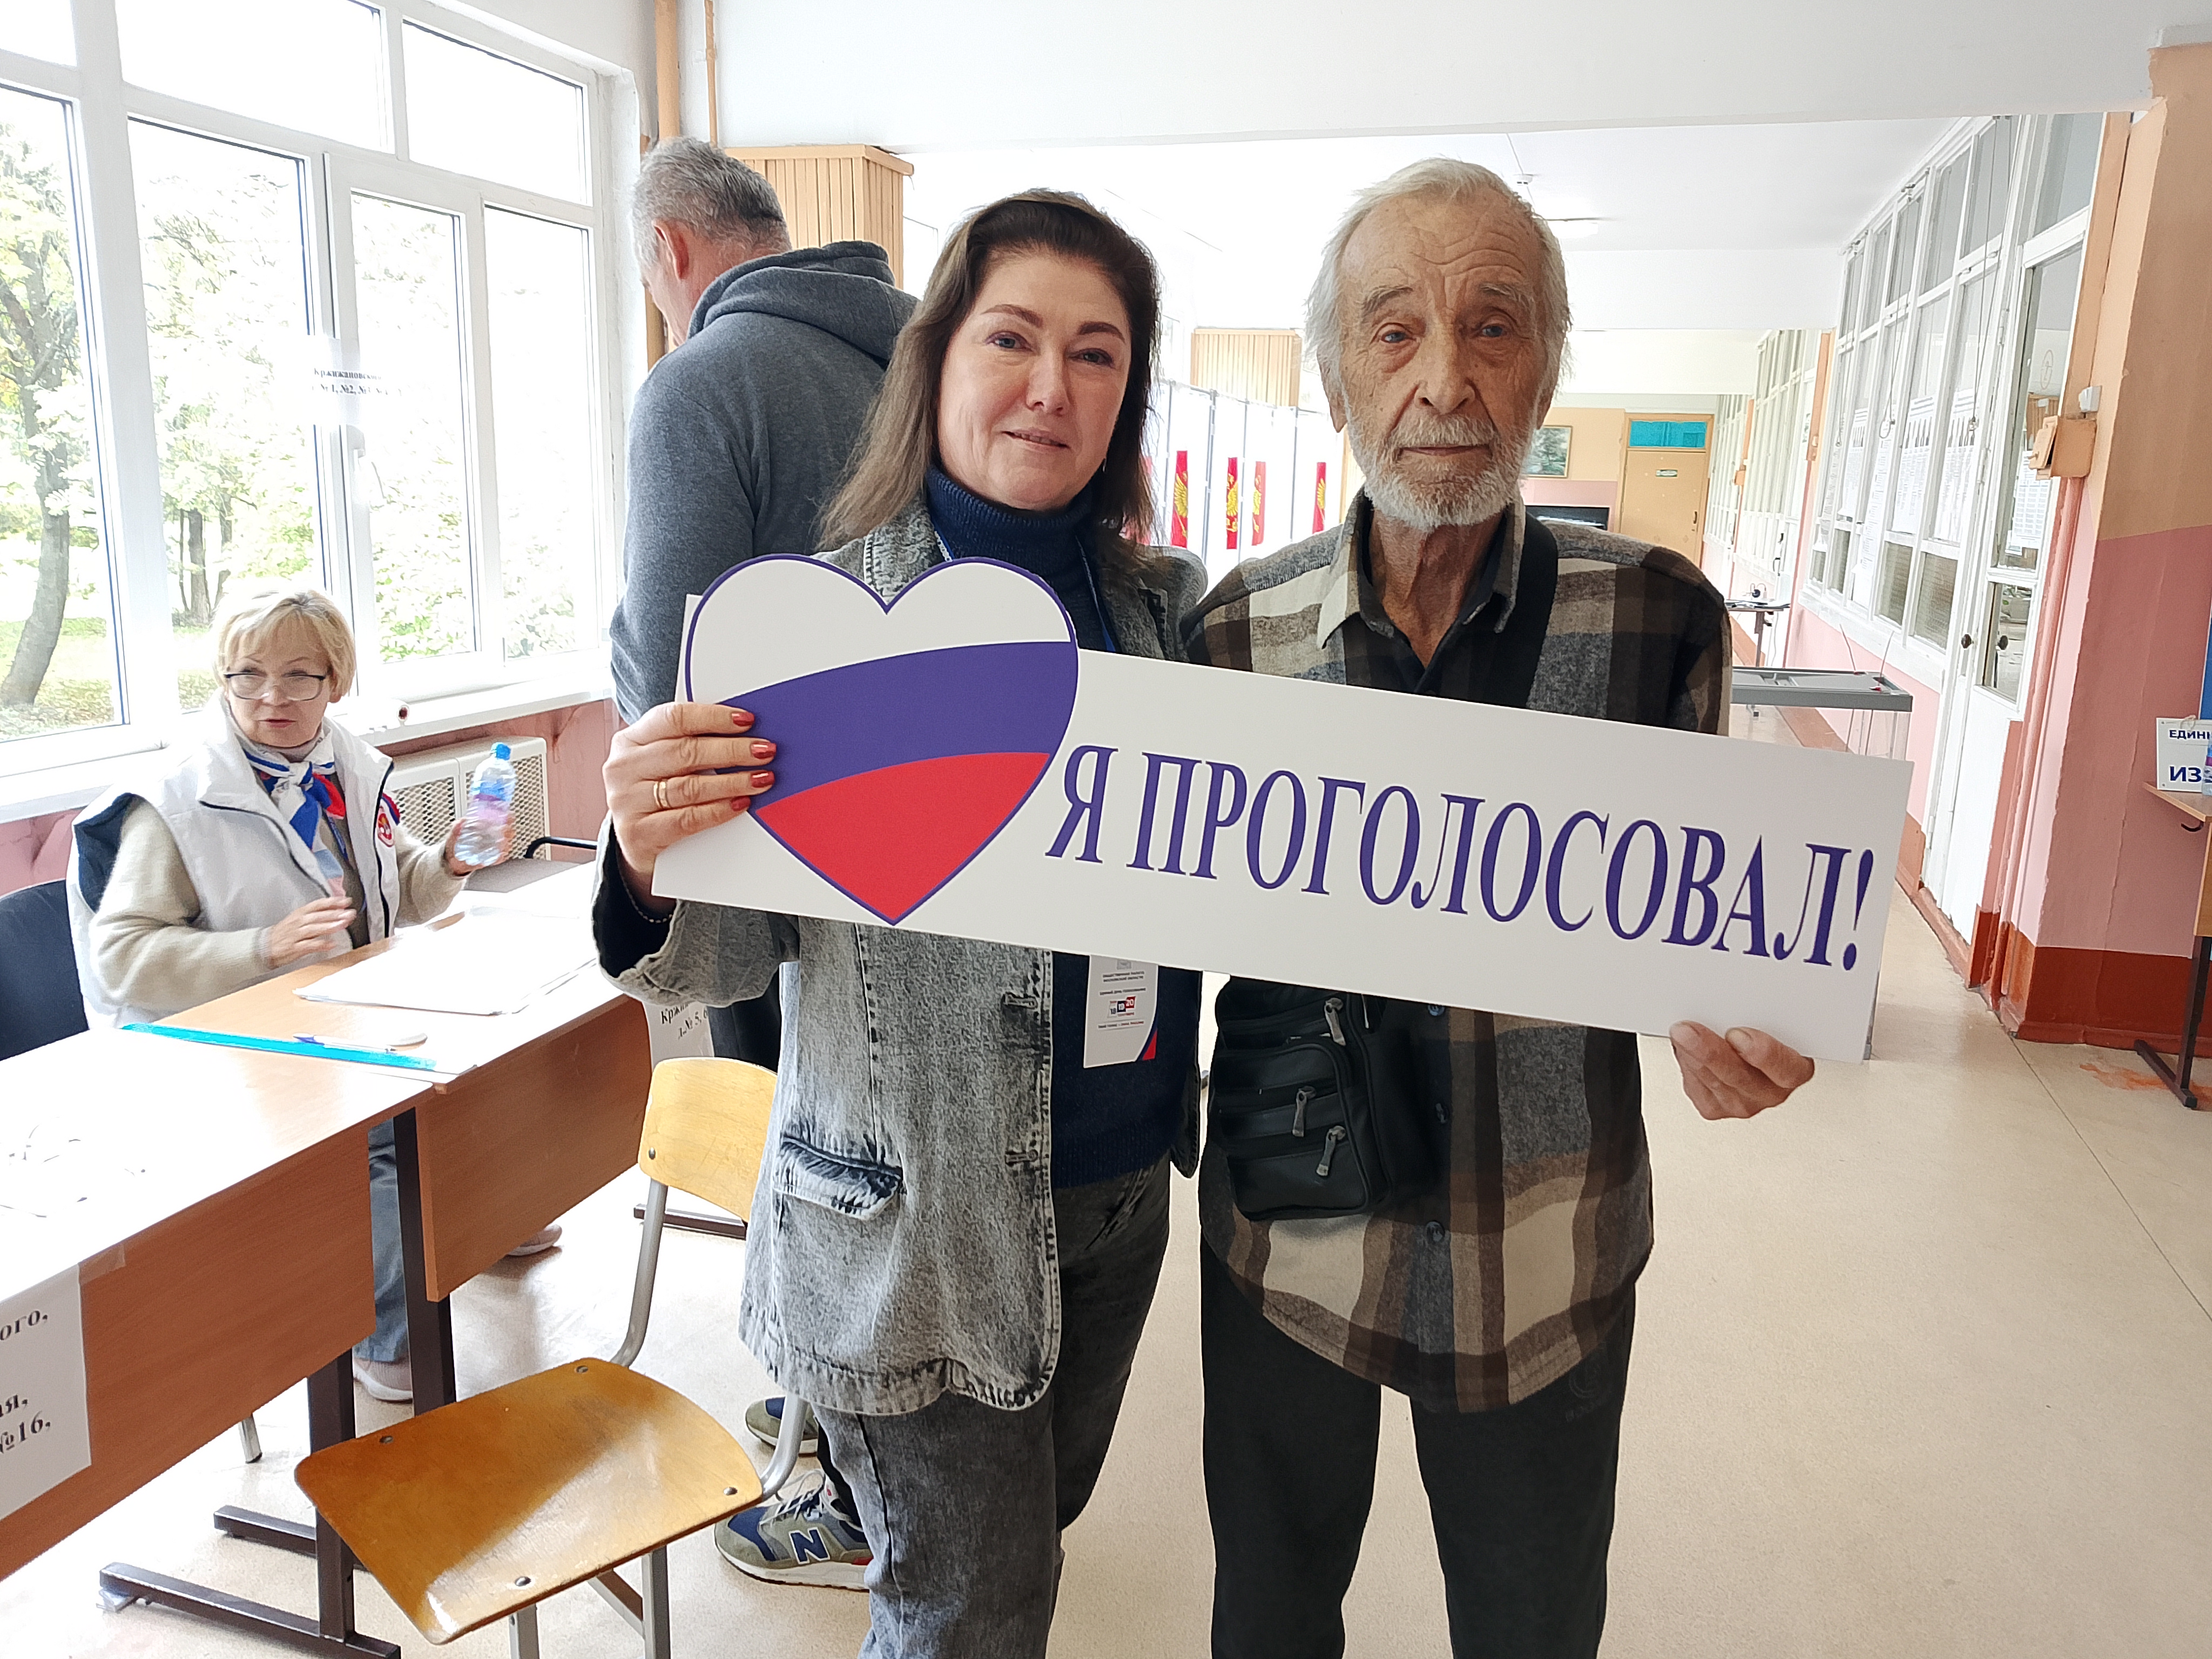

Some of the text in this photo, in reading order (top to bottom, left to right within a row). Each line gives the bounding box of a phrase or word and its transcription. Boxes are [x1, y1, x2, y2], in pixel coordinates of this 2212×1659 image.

[1045, 744, 1874, 971] Я ПРОГОЛОСОВАЛ!
[789, 1527, 831, 1564] N
